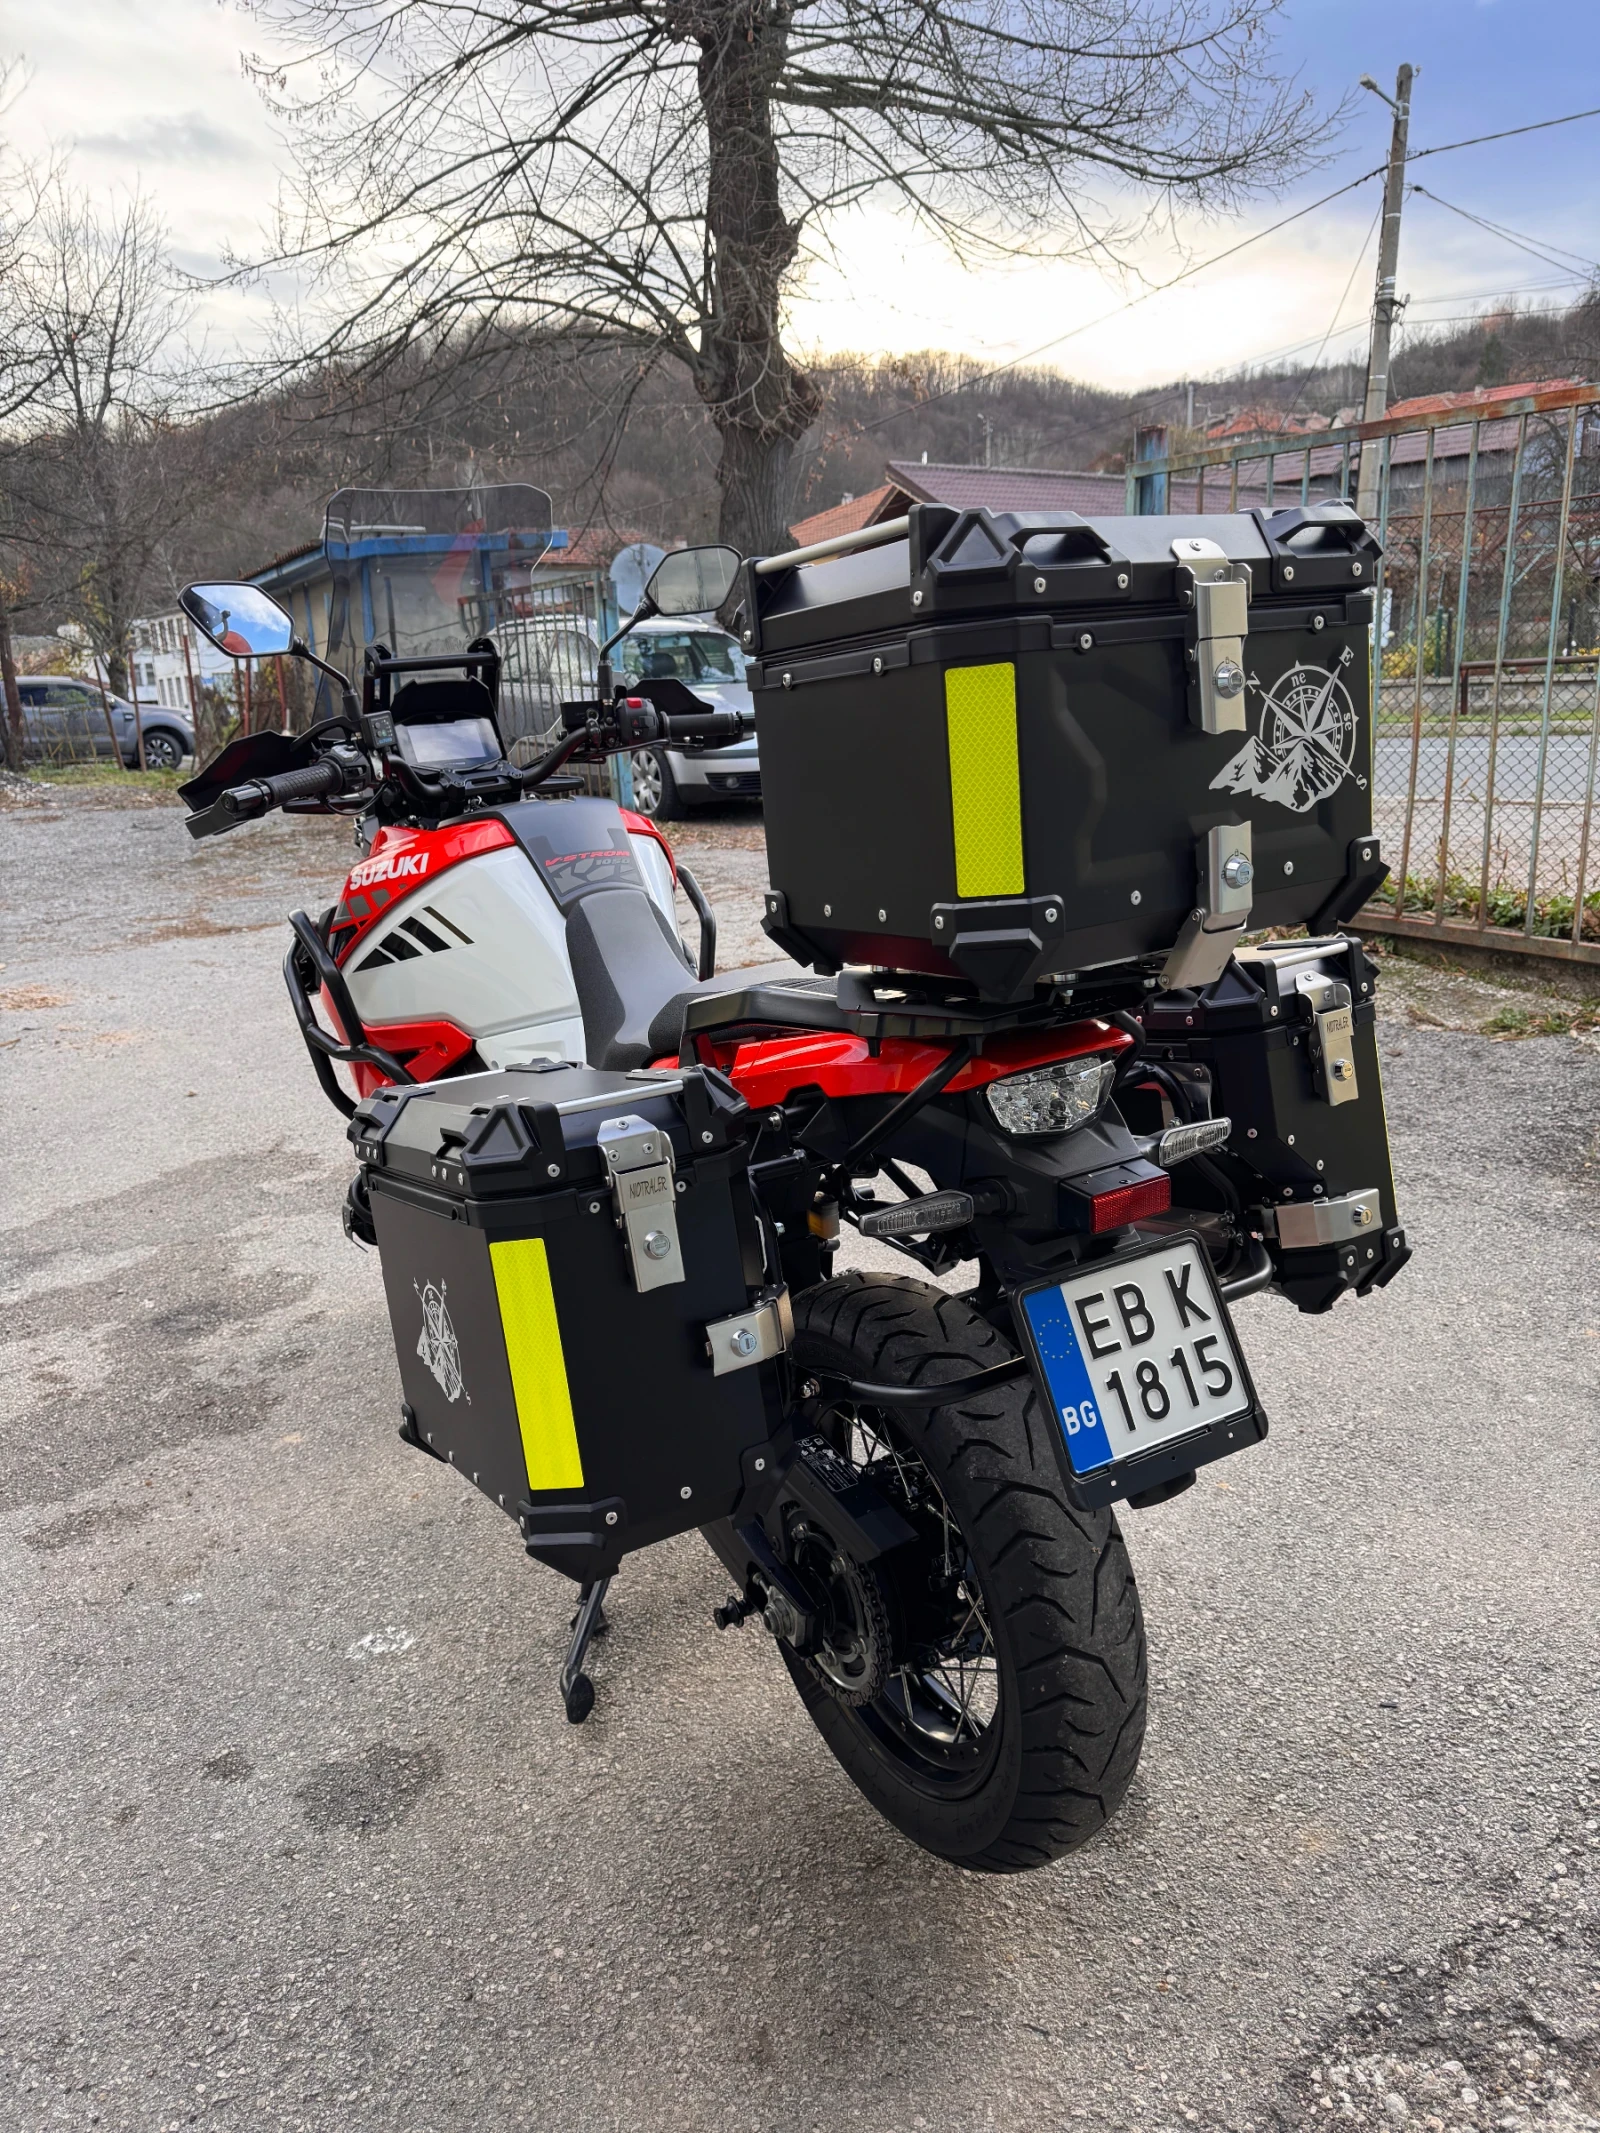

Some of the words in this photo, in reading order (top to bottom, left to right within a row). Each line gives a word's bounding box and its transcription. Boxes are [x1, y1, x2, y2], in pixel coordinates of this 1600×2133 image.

[1339, 645, 1355, 667] E
[1246, 671, 1261, 694] N
[1291, 672, 1306, 687] ne
[1356, 774, 1368, 790] S
[350, 852, 429, 890] SUZUKI
[595, 858, 630, 866] 1050
[1075, 1281, 1155, 1360] EB
[1163, 1261, 1211, 1328] K
[1106, 1334, 1233, 1431] 1815
[1061, 1400, 1097, 1436] BG
